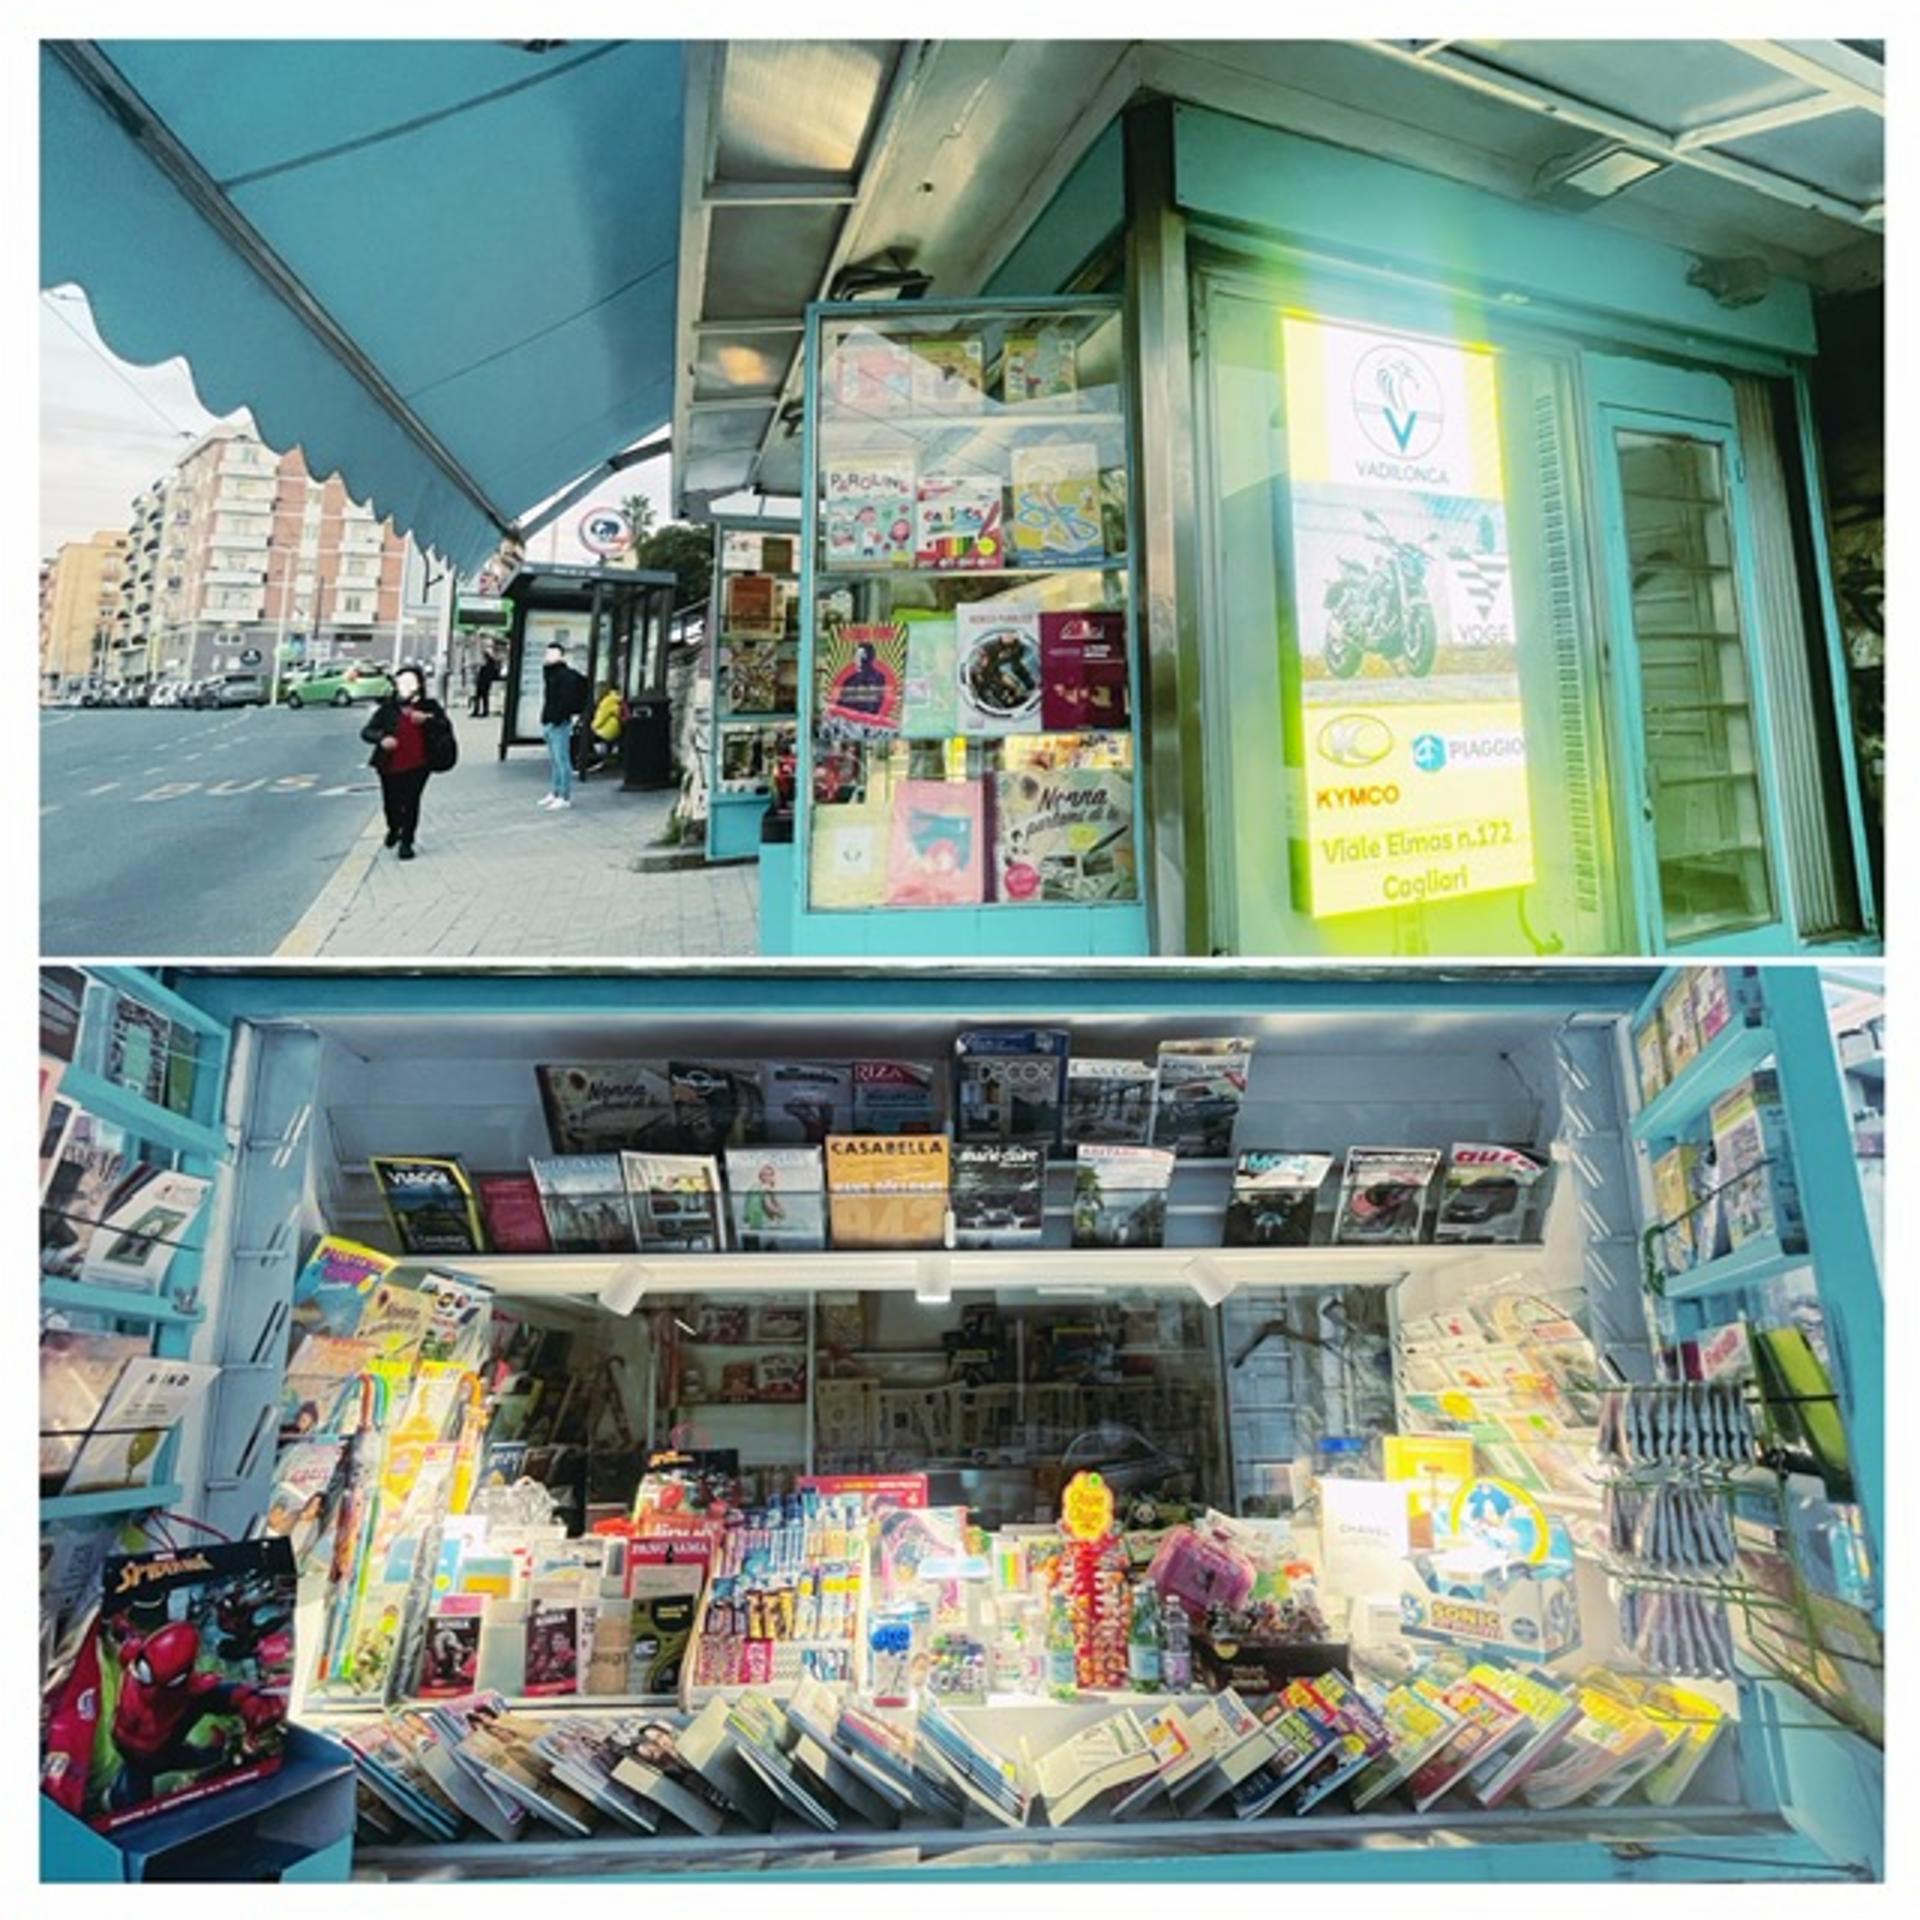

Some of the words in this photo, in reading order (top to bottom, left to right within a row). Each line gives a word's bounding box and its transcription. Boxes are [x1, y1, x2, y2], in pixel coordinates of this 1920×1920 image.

[1448, 736, 1524, 760] PIAGGIO
[1037, 786, 1108, 812] Nonna
[1315, 785, 1400, 809] KYMCO
[1321, 834, 1382, 865] Viale
[1386, 829, 1453, 858] Elmas
[1457, 820, 1514, 851] n.172
[1382, 864, 1470, 903] Cagliari
[830, 1141, 945, 1157] CASABELLA
[631, 1541, 711, 1555] PANOAMA
[1431, 1602, 1501, 1627] SONIC
